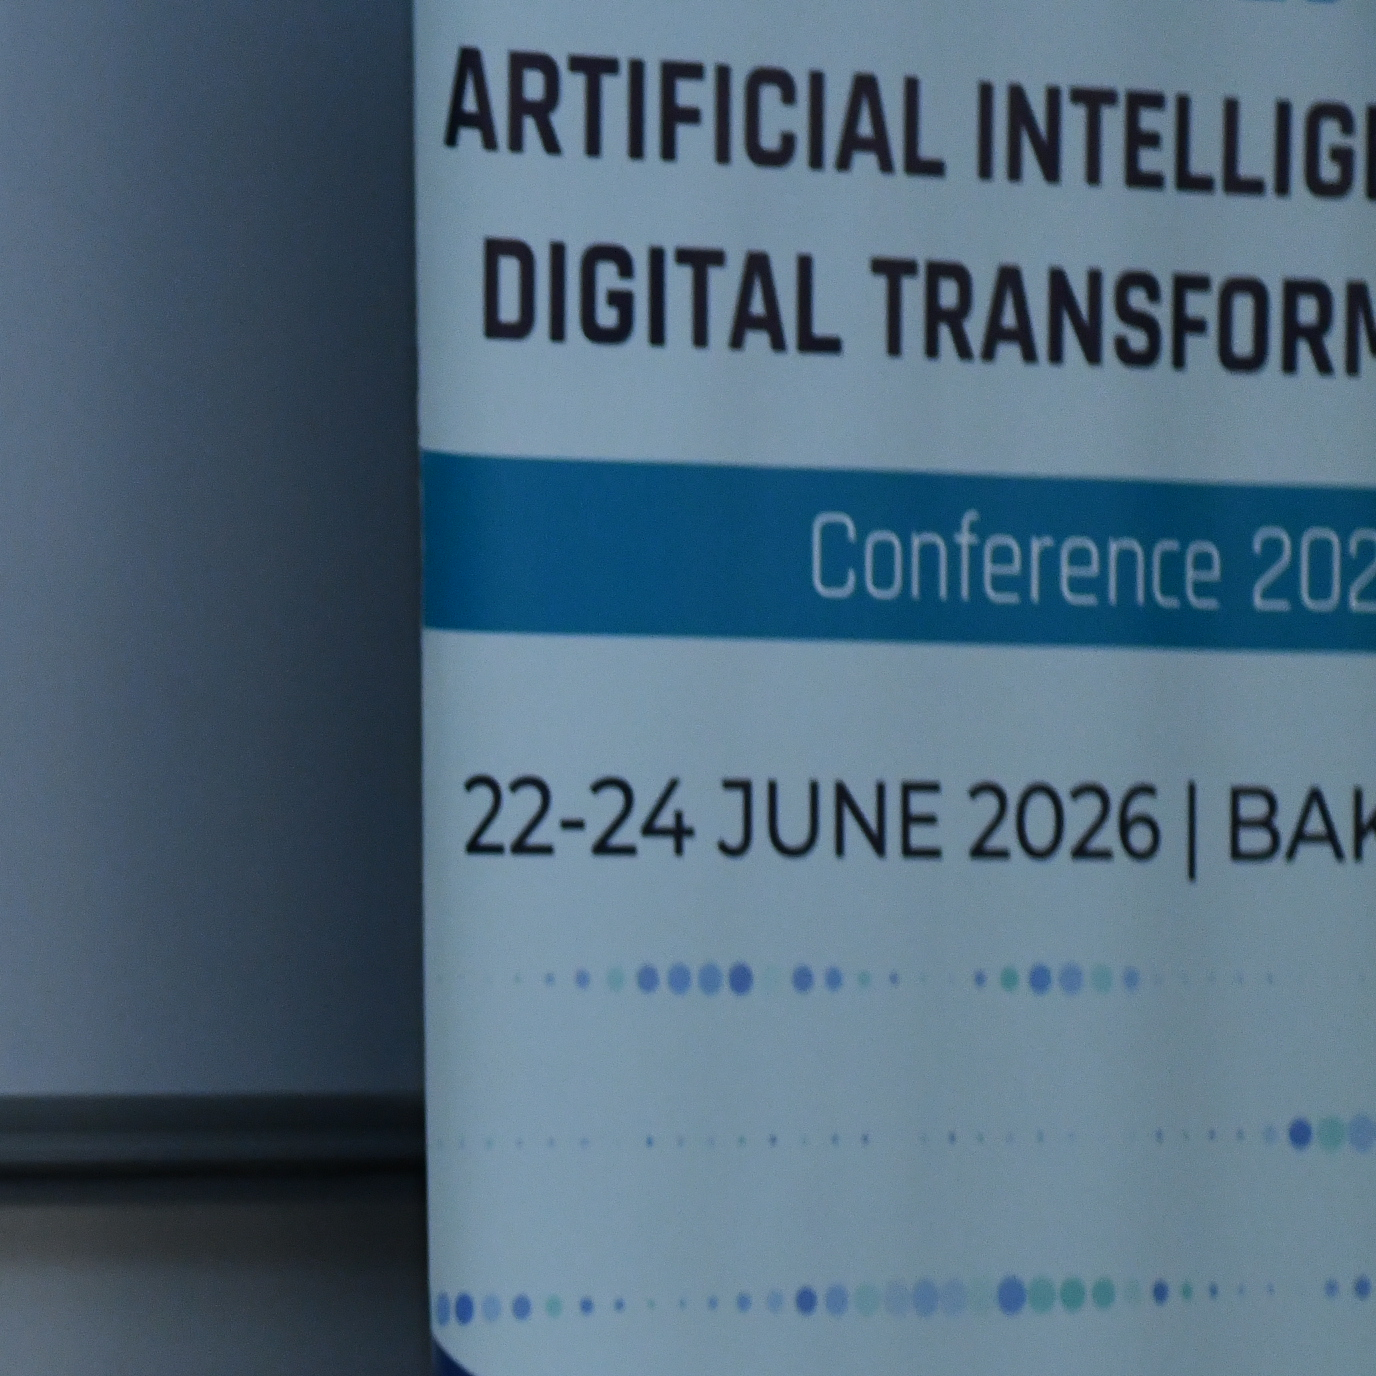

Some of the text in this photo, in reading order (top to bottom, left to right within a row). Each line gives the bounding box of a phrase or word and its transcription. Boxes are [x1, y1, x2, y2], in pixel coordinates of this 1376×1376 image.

[442, 44, 1376, 205] ARTIFICIAL INTELLIG
[481, 235, 844, 357] DIGITAL
[810, 509, 1222, 610] Conference
[462, 773, 697, 858] 22-24
[716, 777, 944, 861] JUNE
[967, 780, 1163, 864] 2026
